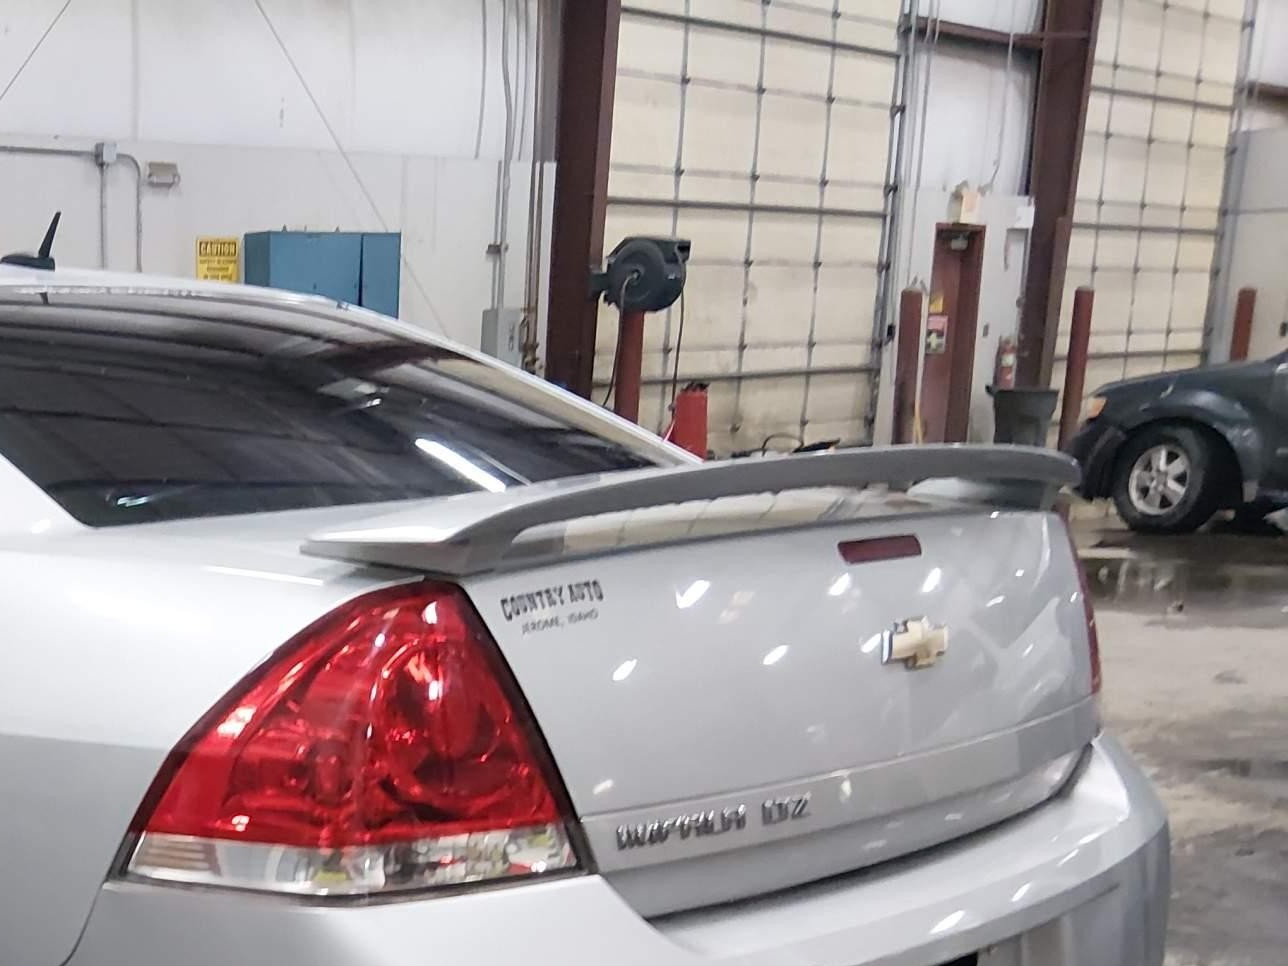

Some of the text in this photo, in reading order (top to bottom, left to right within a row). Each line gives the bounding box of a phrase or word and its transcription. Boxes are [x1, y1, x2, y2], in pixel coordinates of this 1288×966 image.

[199, 242, 236, 256] CAUTION
[500, 580, 604, 621] COUNTRY AUTO
